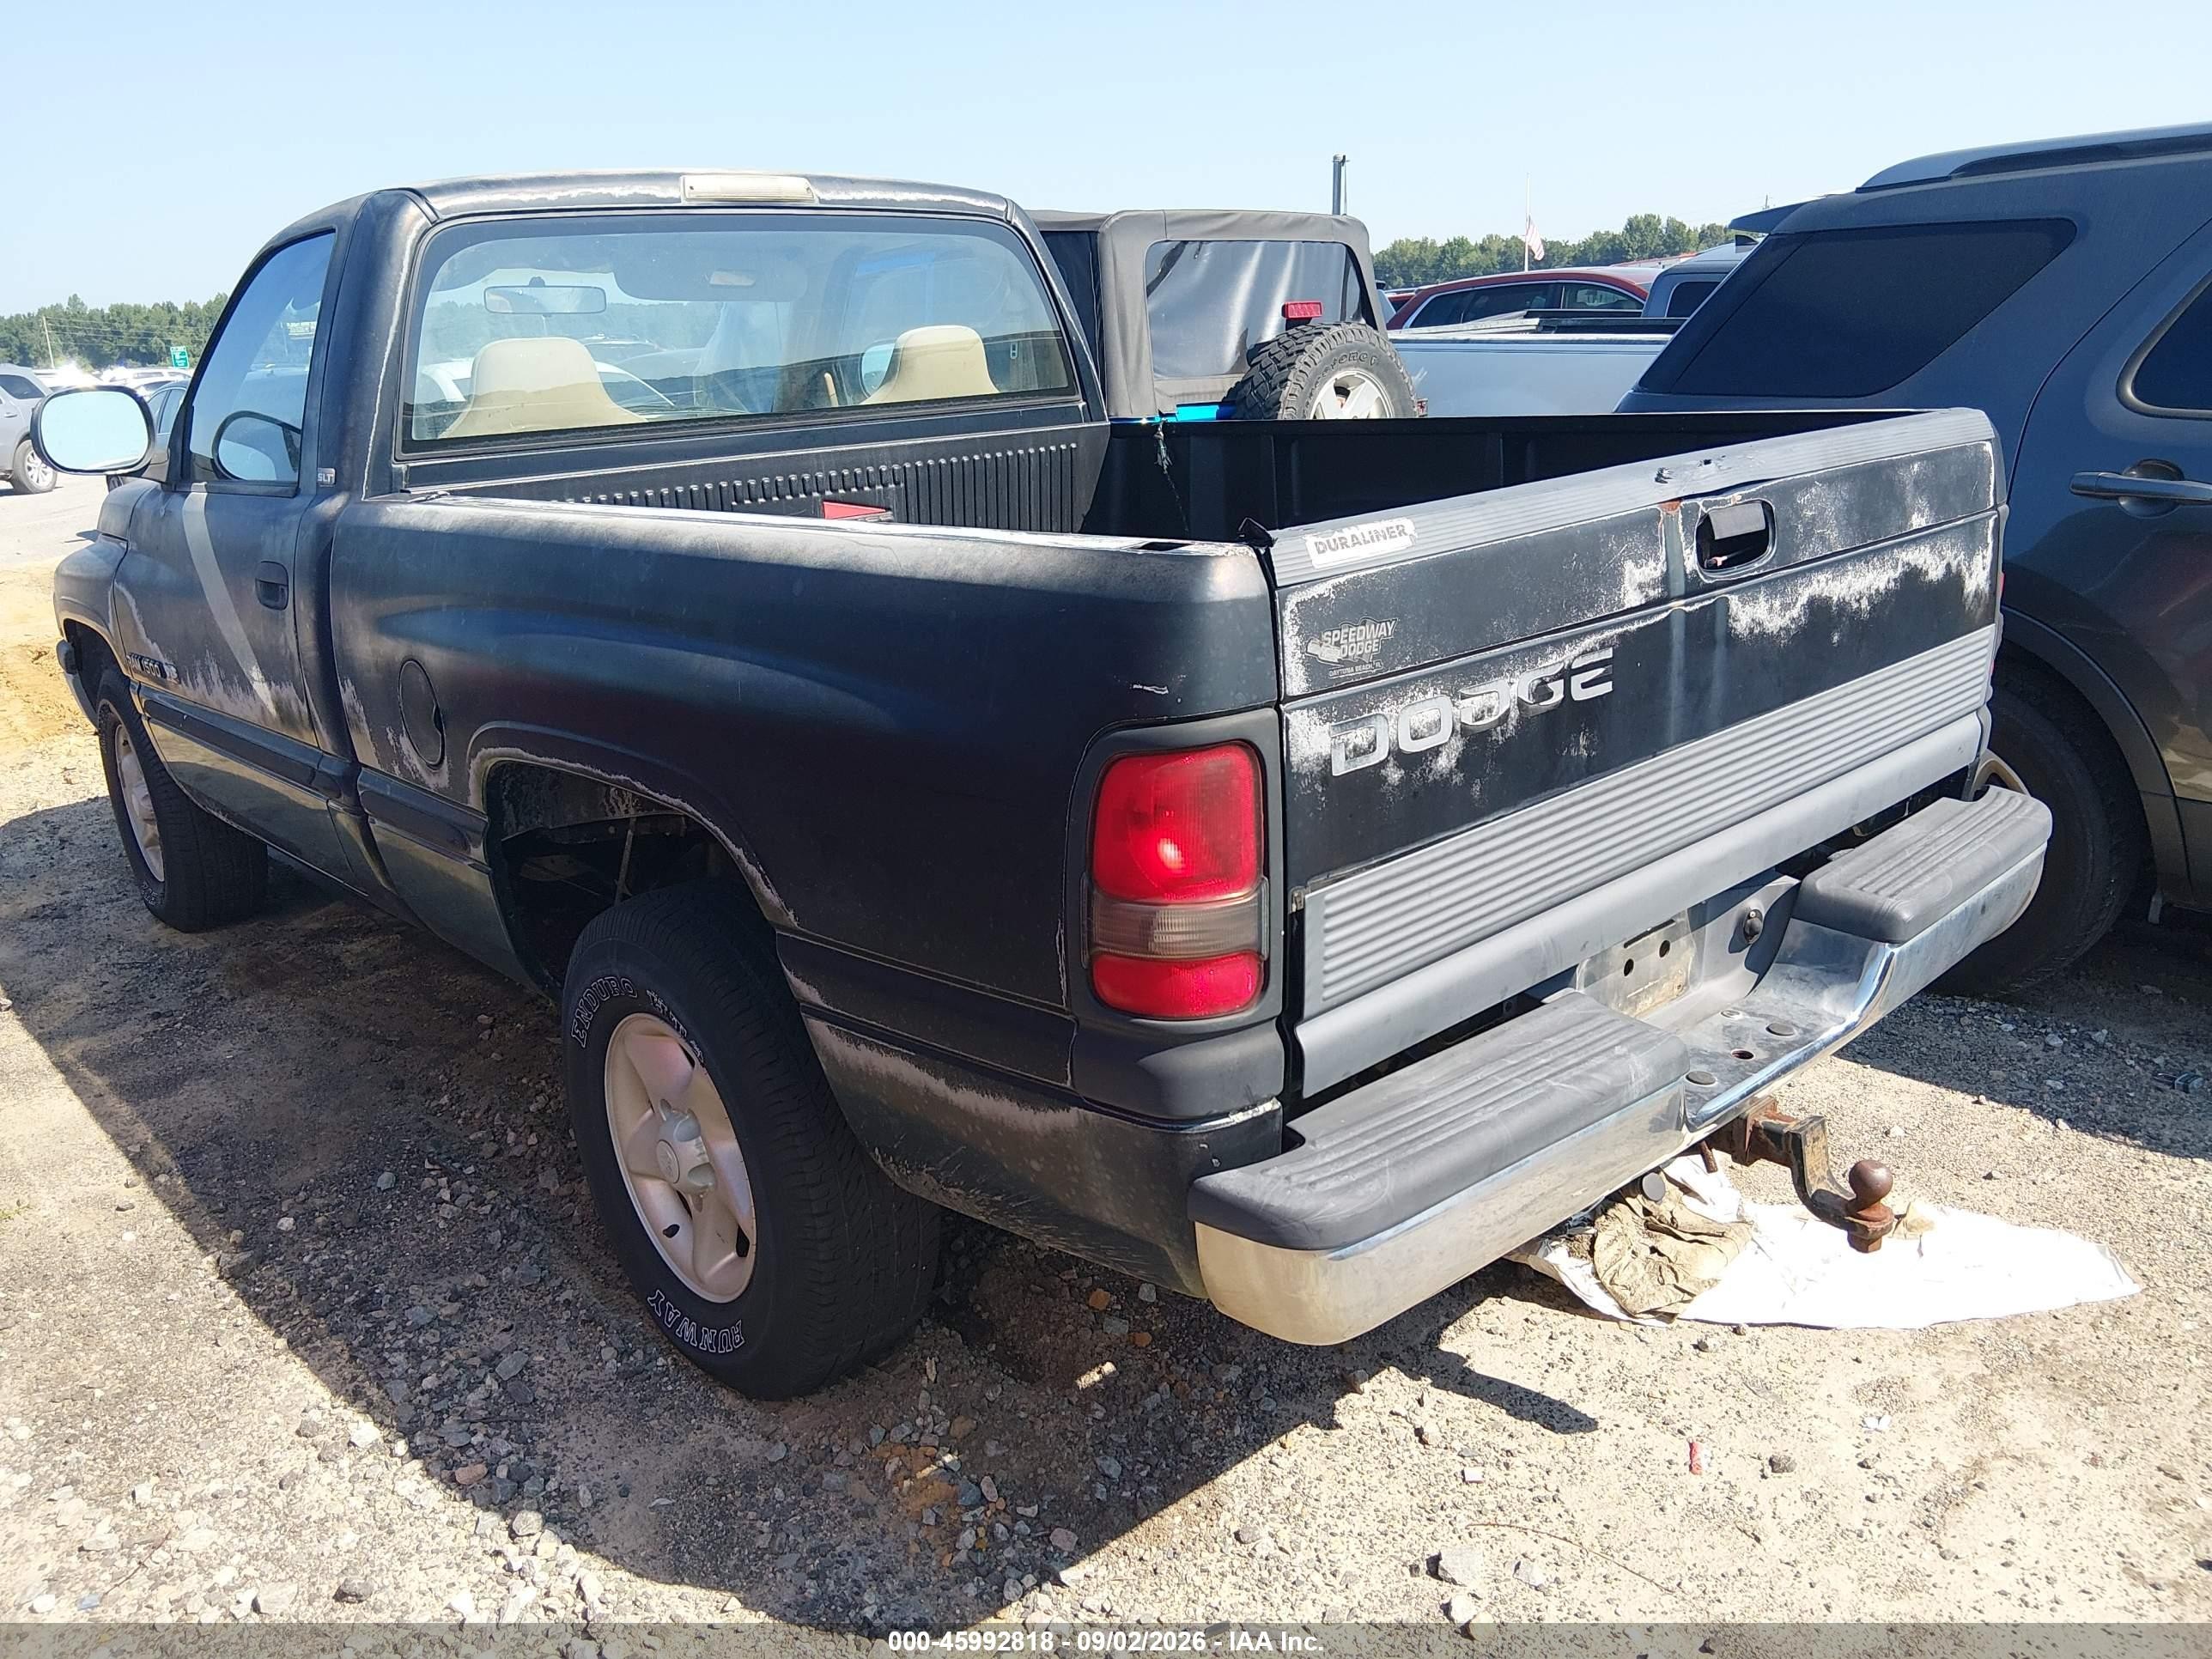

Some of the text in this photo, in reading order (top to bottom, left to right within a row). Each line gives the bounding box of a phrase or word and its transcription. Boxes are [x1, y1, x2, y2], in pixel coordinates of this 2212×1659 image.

[317, 472, 334, 483] SLT
[1314, 524, 1408, 554] DURALINER
[1322, 619, 1396, 647] SPEEDWAY
[1340, 638, 1379, 659] DODGE
[1330, 647, 1613, 777] DODGE
[570, 975, 638, 1049] ENDURO
[647, 1289, 745, 1354] RUNWAY
